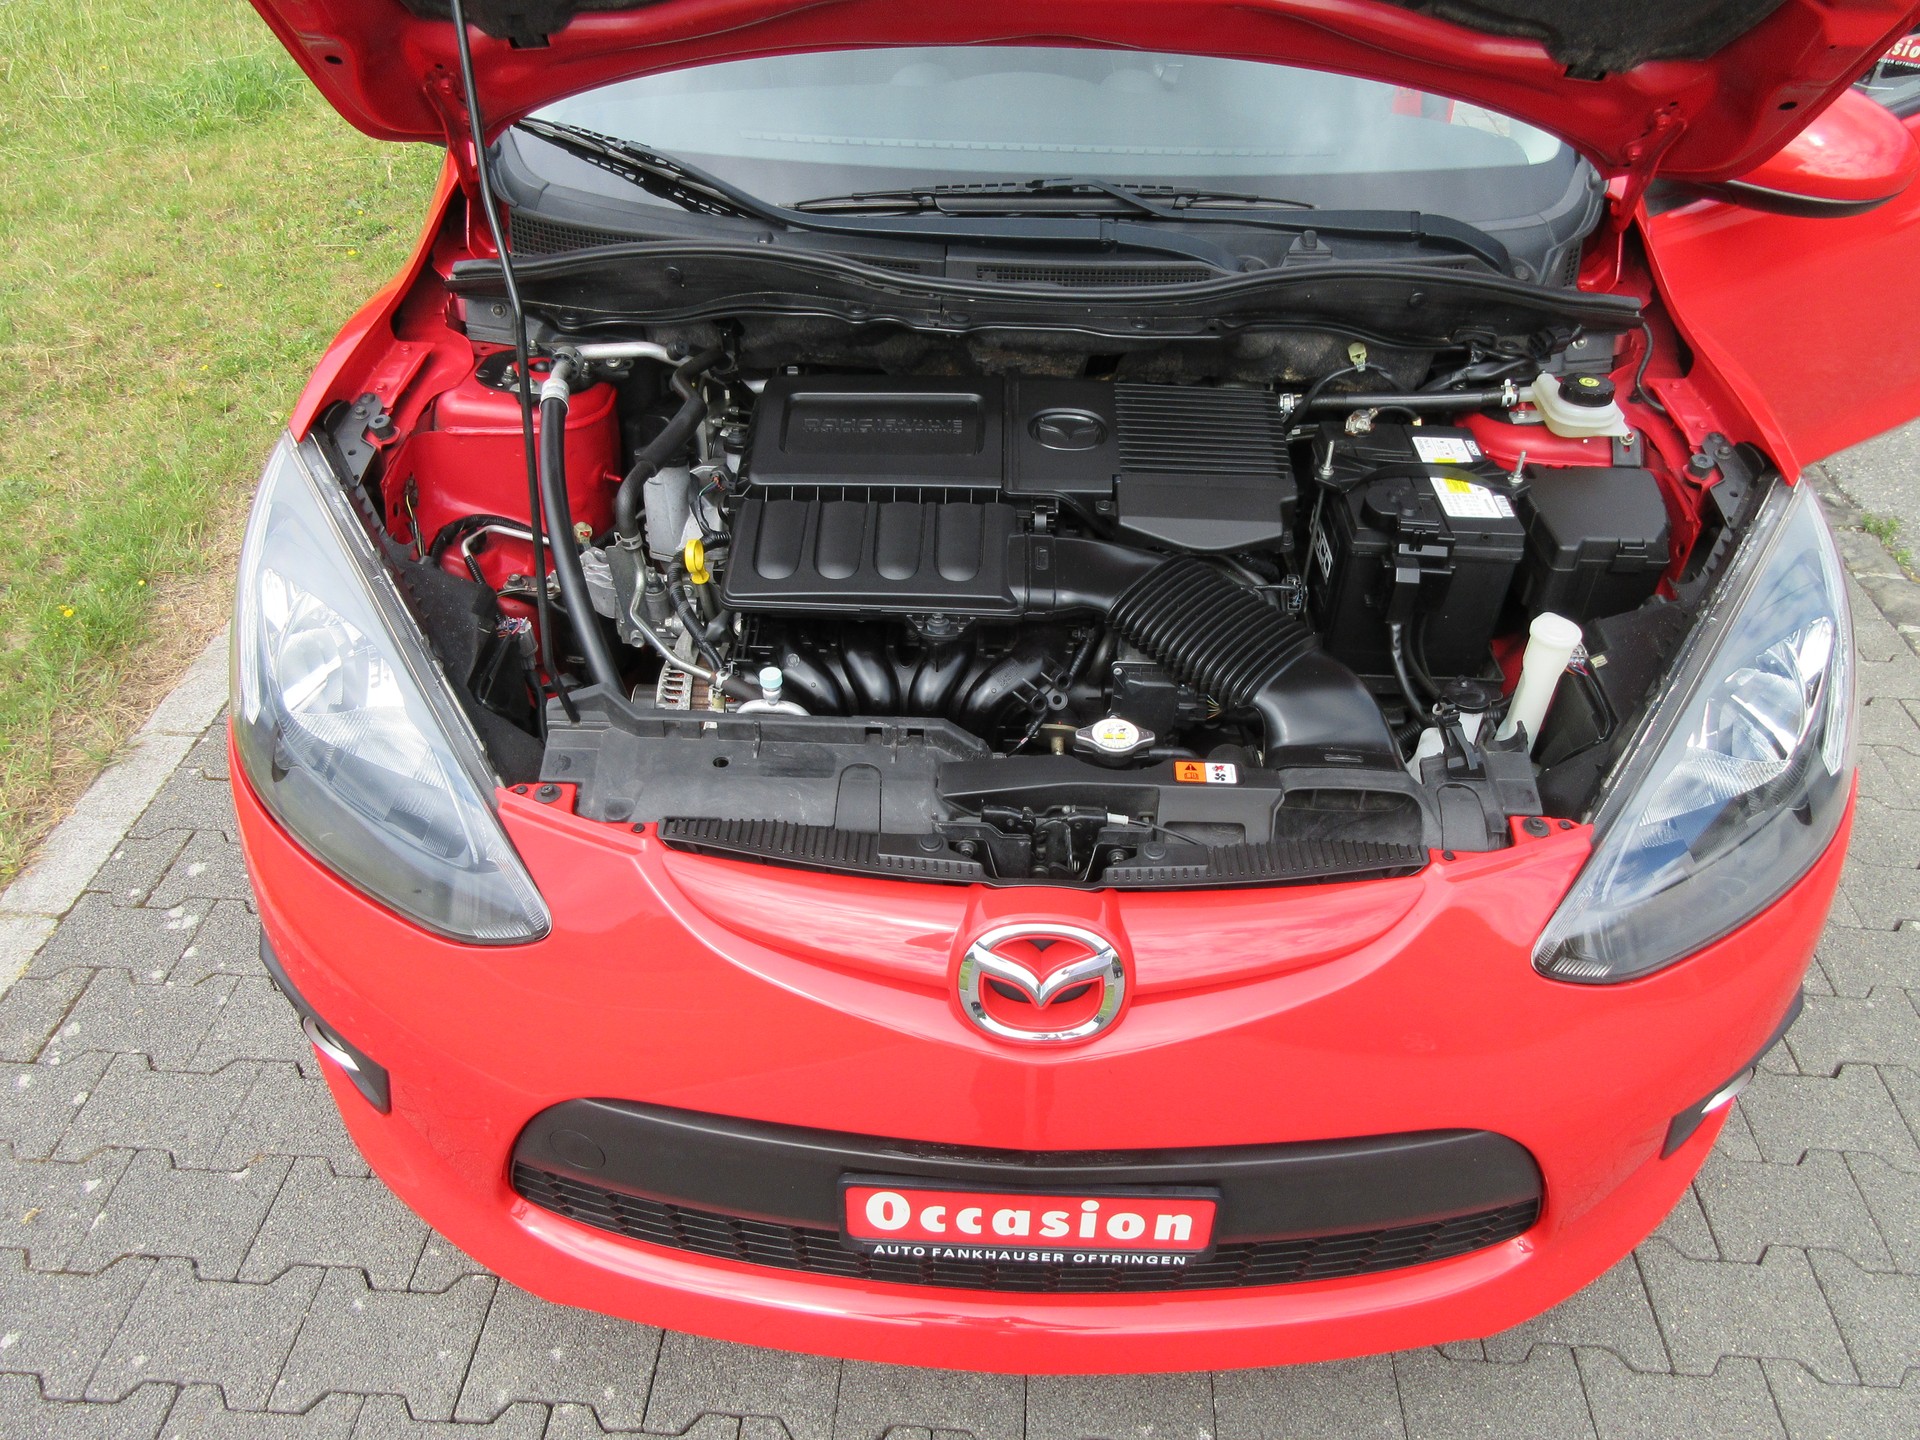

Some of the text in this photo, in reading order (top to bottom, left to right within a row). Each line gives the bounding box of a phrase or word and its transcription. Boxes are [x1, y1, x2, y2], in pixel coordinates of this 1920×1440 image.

[865, 1191, 1193, 1241] Occasion
[873, 1244, 1186, 1266] AUTO FANKHAUSER OFTRINGEN
